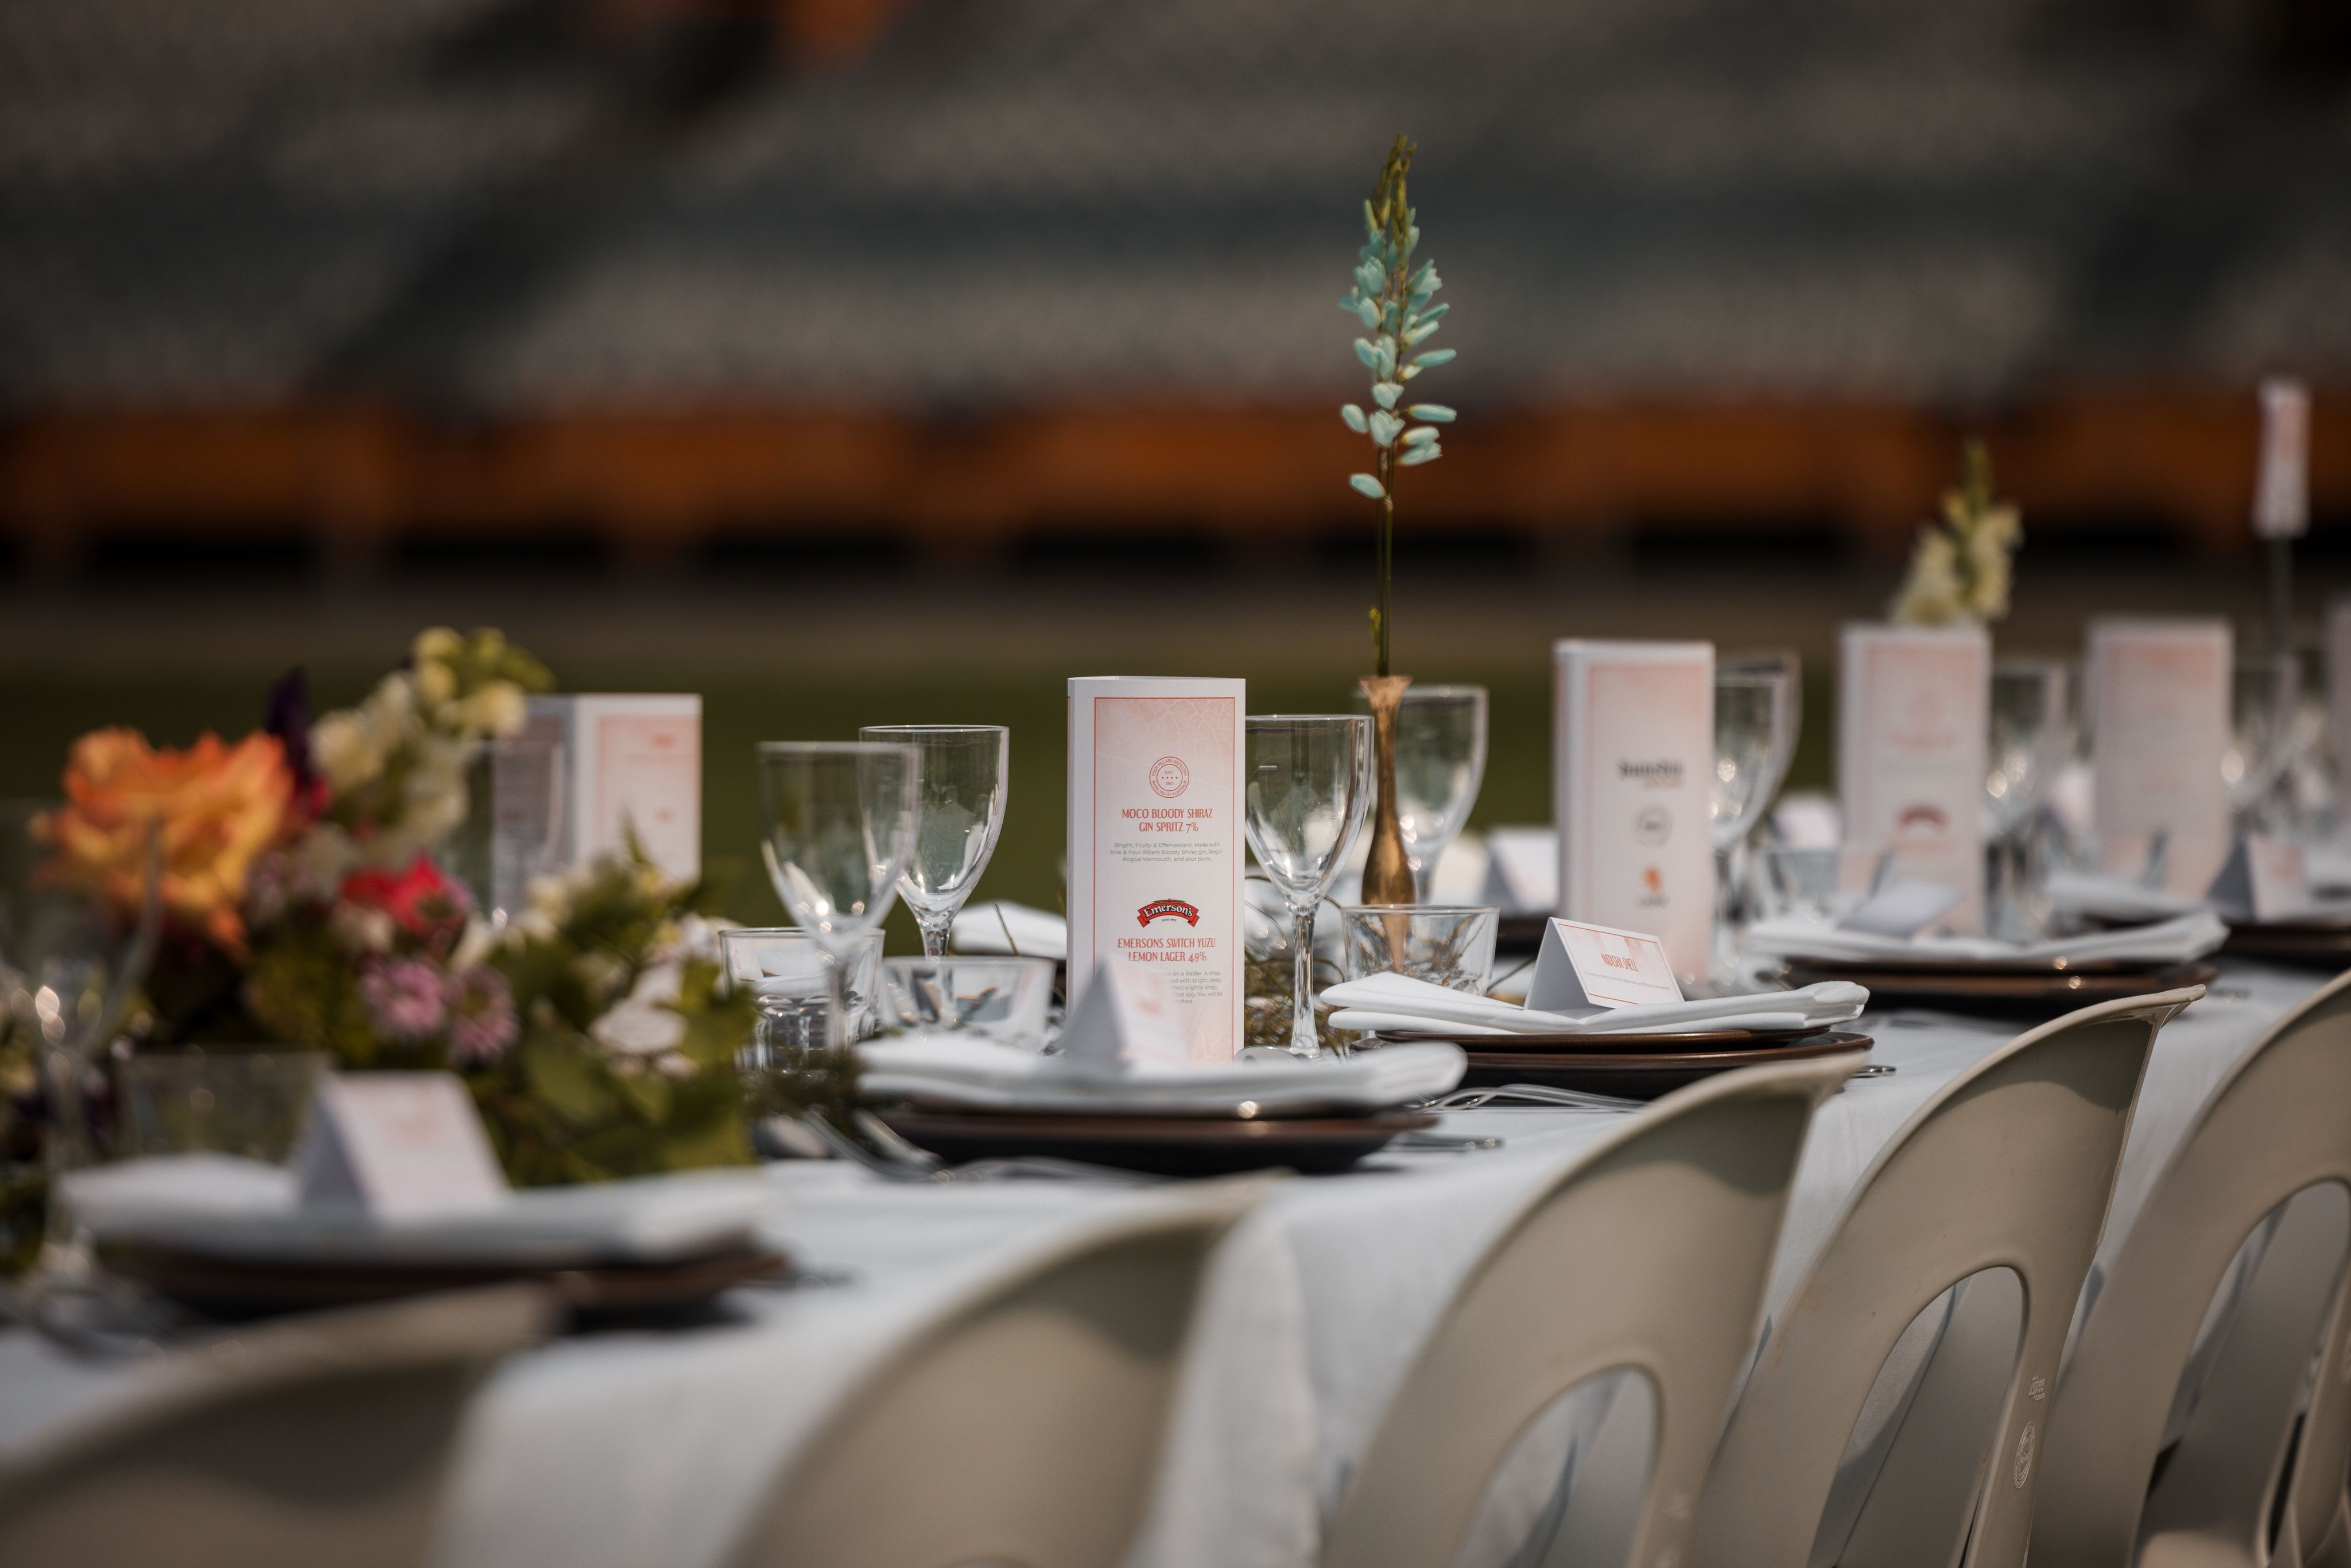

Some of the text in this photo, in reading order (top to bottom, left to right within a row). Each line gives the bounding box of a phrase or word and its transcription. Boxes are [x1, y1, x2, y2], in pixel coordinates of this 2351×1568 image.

[1122, 808, 1213, 818] MOCO BLOODY SHIRAZ
[1139, 822, 1199, 833] GIN SPRITZ 7%
[1143, 905, 1193, 918] Emerson's
[1118, 938, 1216, 948] EMERSONS SWITCH YUZU
[1128, 951, 1207, 963] LEMON LAGER 4.9%
